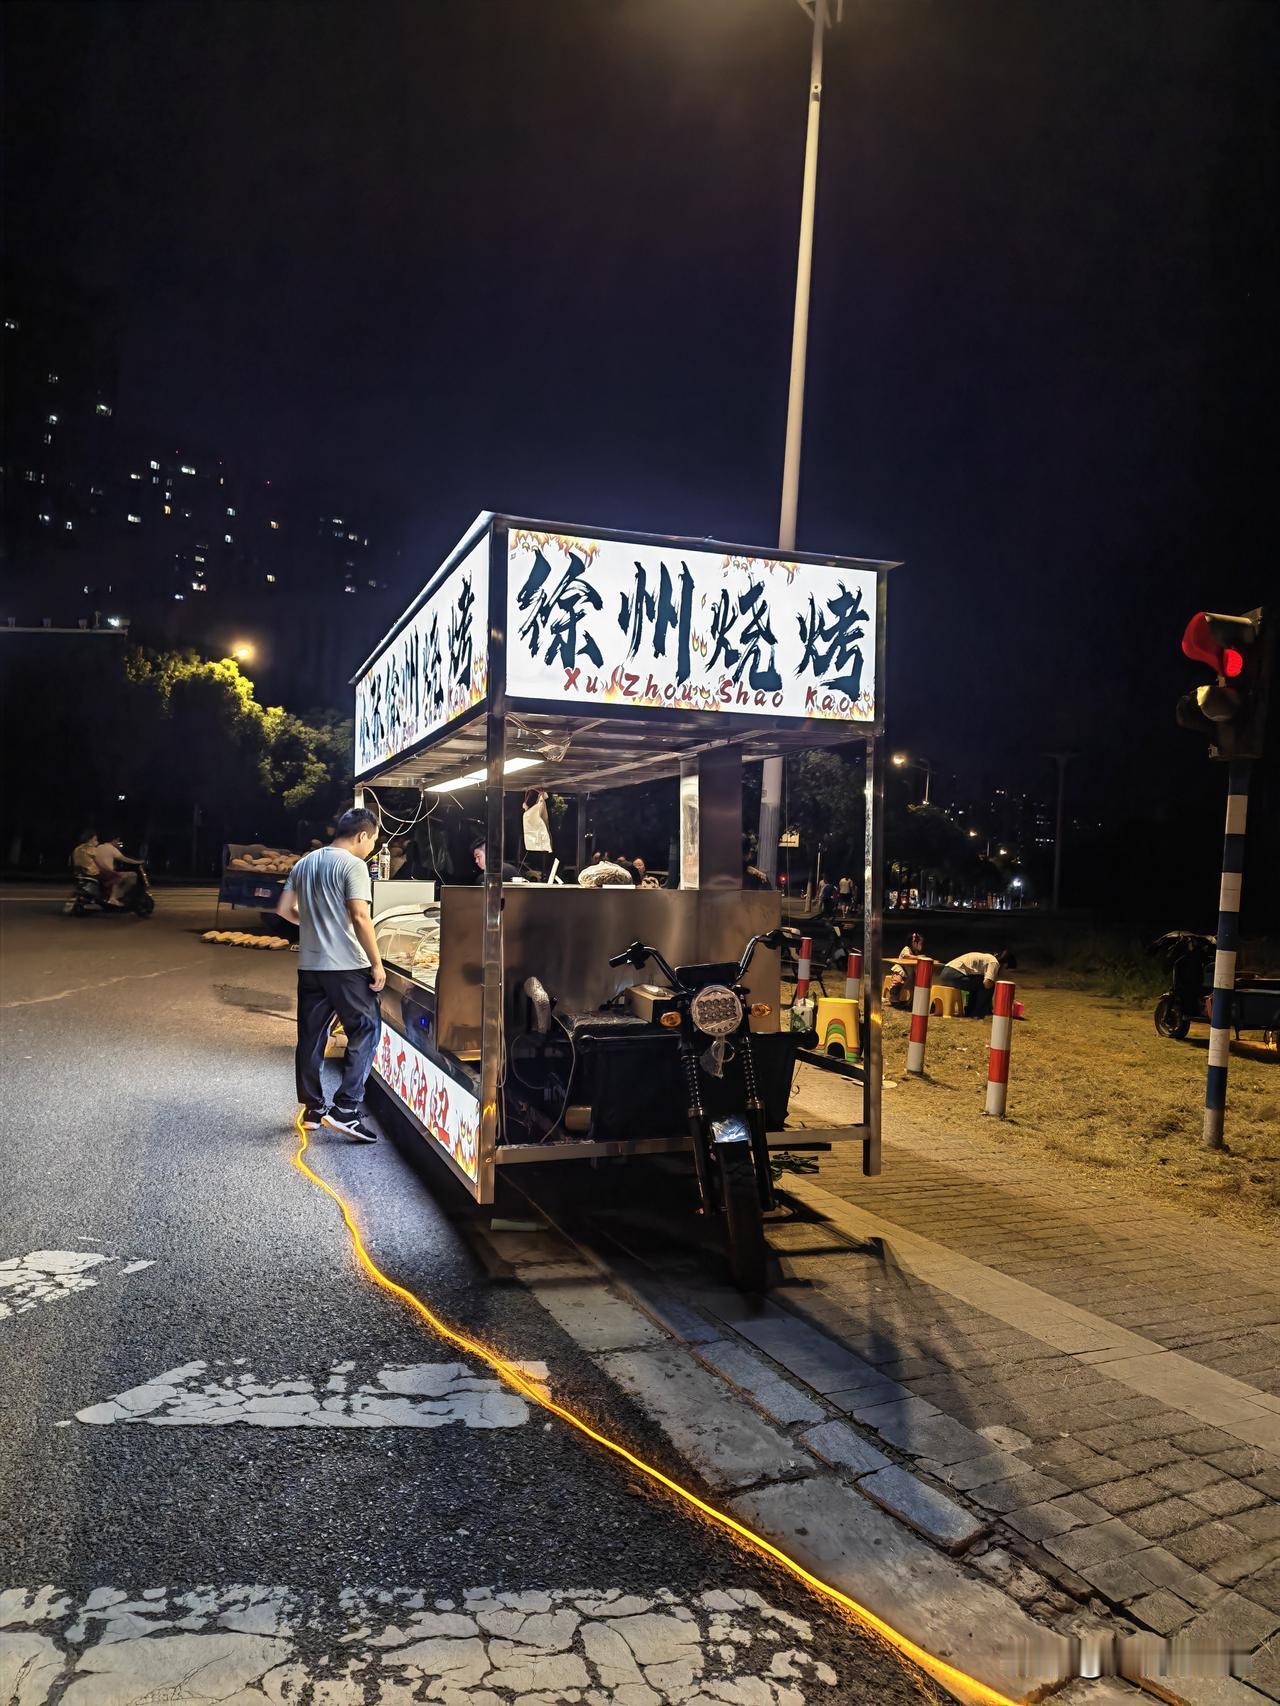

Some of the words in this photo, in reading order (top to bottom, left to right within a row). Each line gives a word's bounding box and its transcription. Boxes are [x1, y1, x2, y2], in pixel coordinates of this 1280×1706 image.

[517, 551, 870, 701] 徐州烧烤
[563, 667, 599, 694] Xu
[622, 672, 694, 699] Zhou
[719, 679, 784, 709] Shao
[804, 686, 850, 713] Kao
